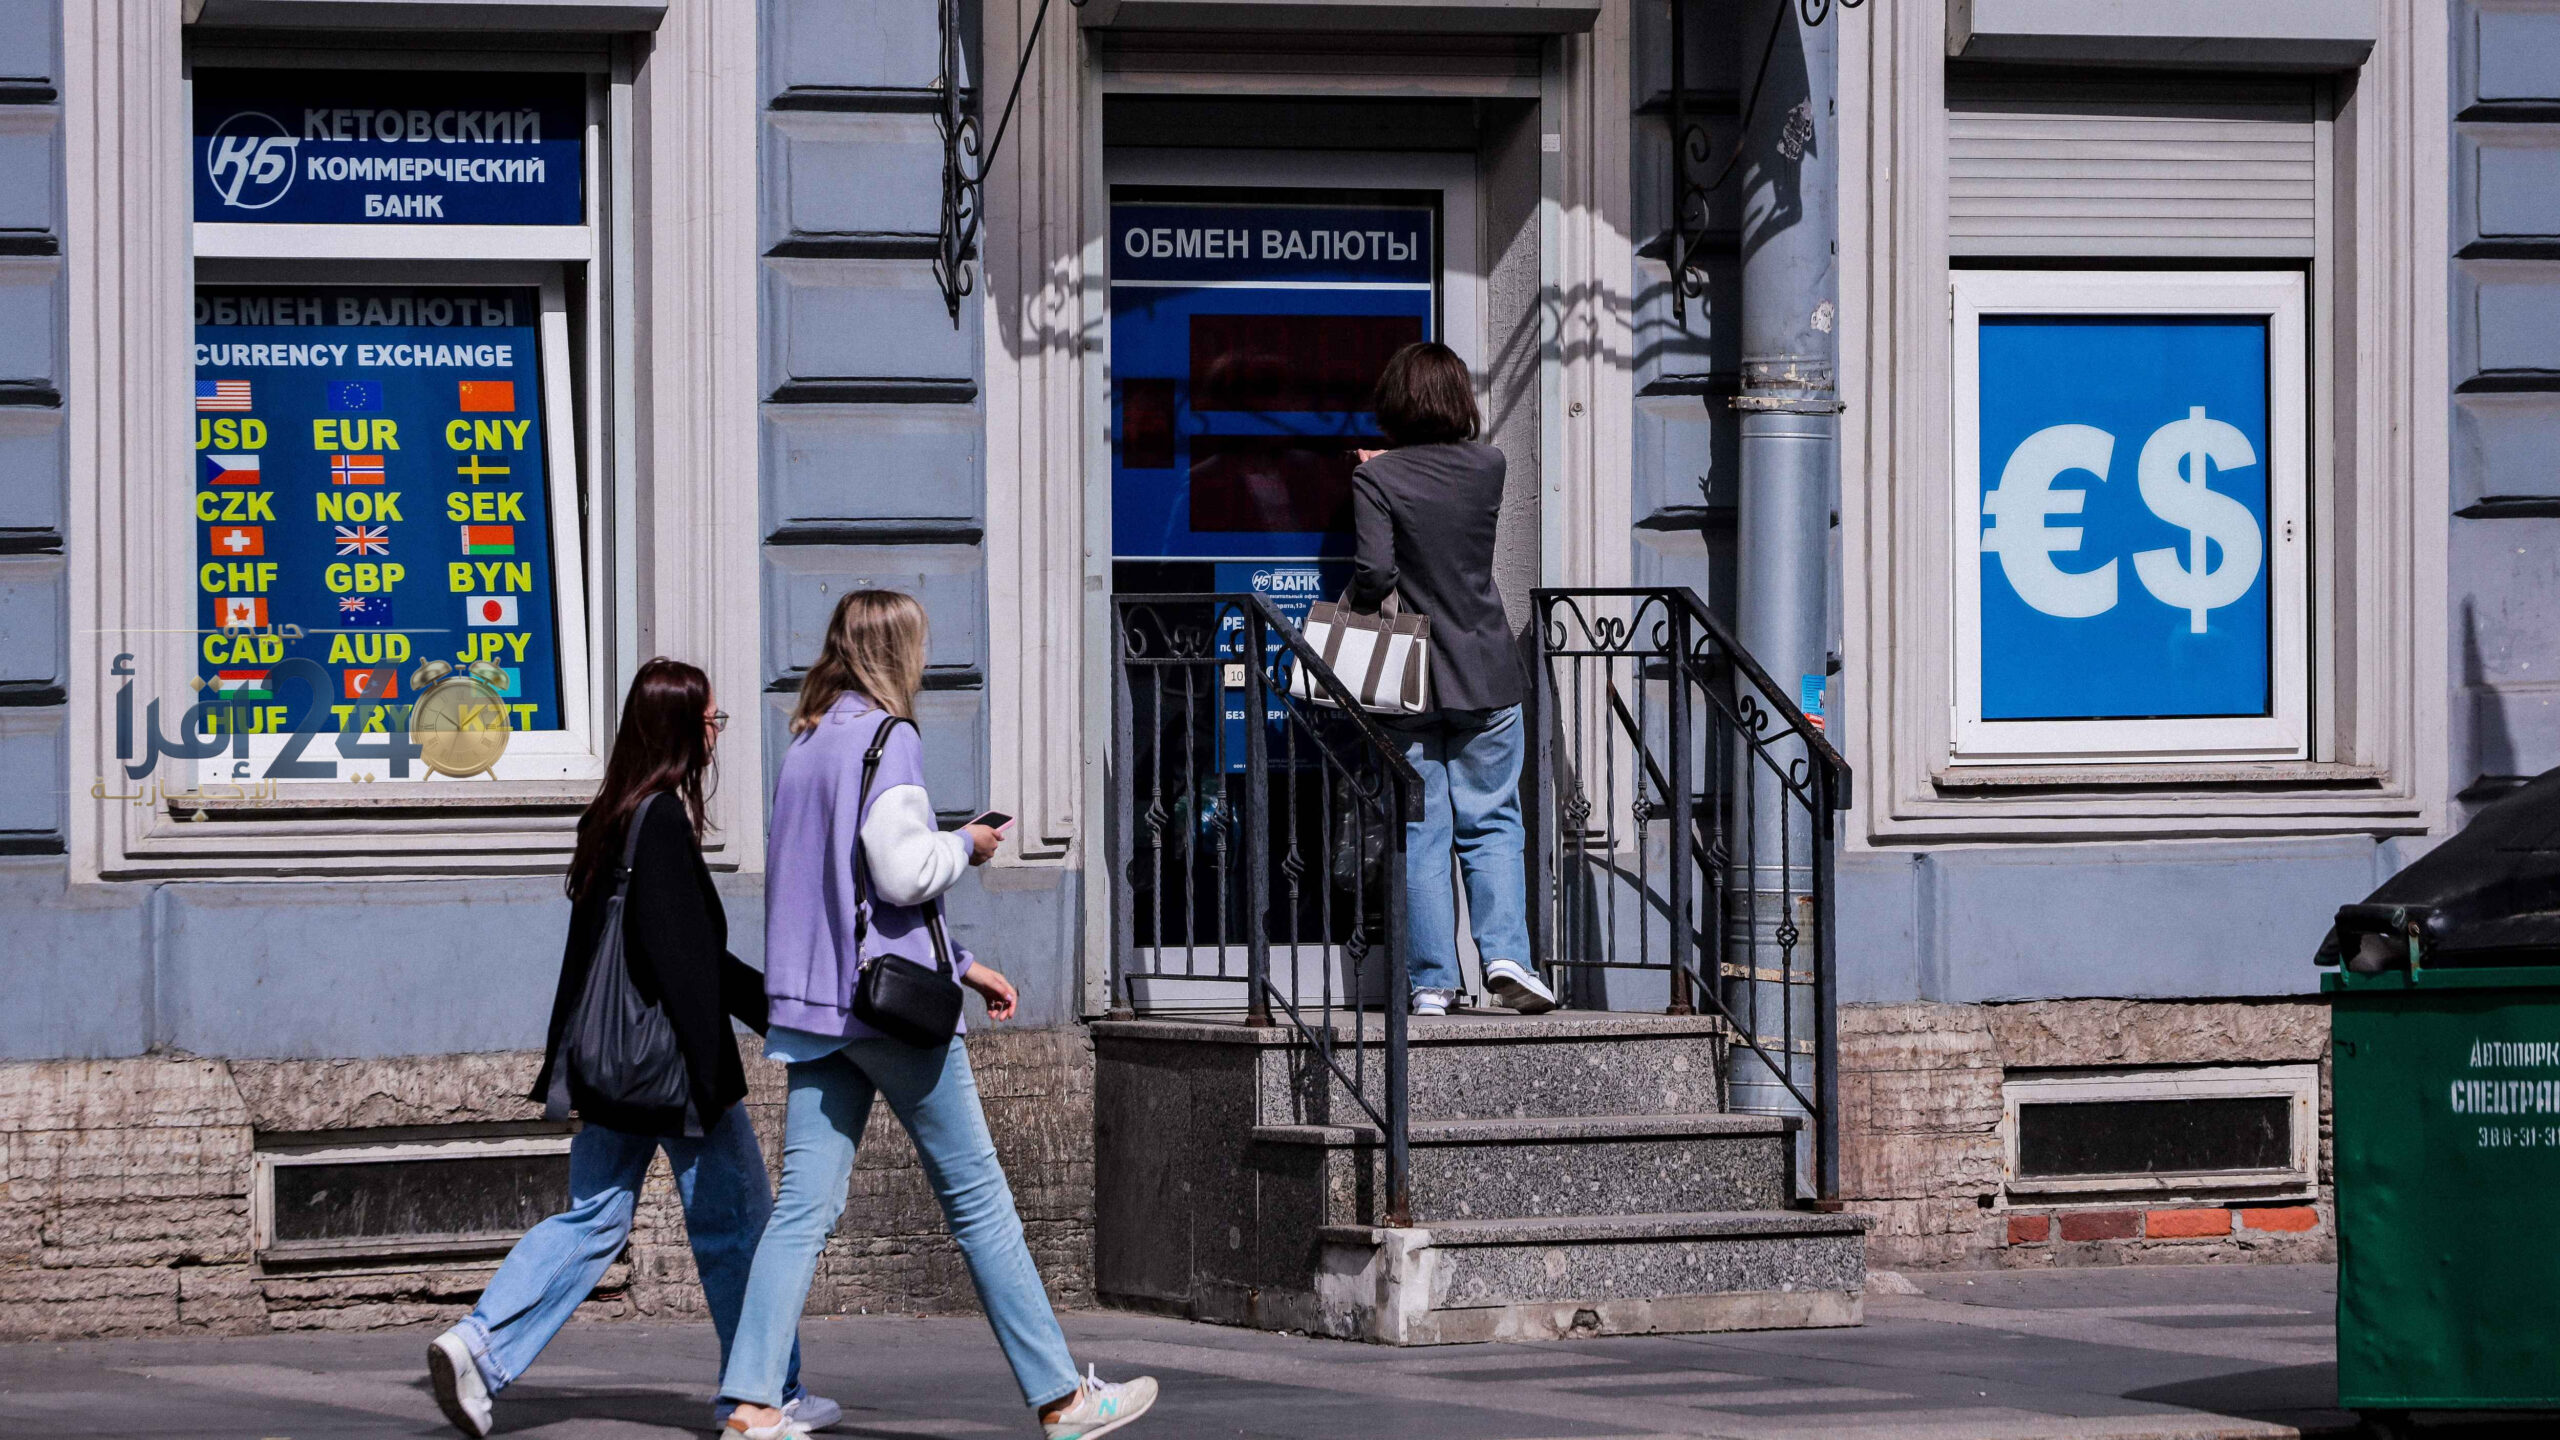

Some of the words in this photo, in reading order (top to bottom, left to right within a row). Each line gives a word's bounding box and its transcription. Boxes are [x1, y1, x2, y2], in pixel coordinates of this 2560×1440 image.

[304, 108, 541, 144] КЕТОВСКИЙ
[307, 156, 546, 183] КОММЕРЧЕСКИЙ
[364, 194, 444, 218] БАНК
[1124, 227, 1250, 259] ОБМЕН
[1261, 229, 1418, 261] ВАЛЮТЫ
[337, 297, 514, 327] ВАЛЮТЫ
[195, 343, 349, 368] CURRENCY
[357, 343, 513, 367] EXCHANGE
[313, 419, 400, 450] EUR
[445, 419, 531, 450] CNY
[197, 491, 276, 521] CZK
[316, 492, 404, 522] NOK
[446, 492, 526, 521] SEK
[200, 562, 278, 593] CHF
[325, 562, 406, 593] GBP
[449, 562, 532, 593] BYN
[1272, 574, 1321, 591] БАНК
[203, 633, 285, 665] CAD
[328, 633, 411, 664] AUD
[456, 633, 532, 663] JPY
[206, 705, 288, 735] HUF
[331, 704, 415, 734] TRY
[457, 703, 538, 733] KZT
[1225, 711, 1245, 720] БЕЗ
[1098, 1397, 1118, 1417] N
